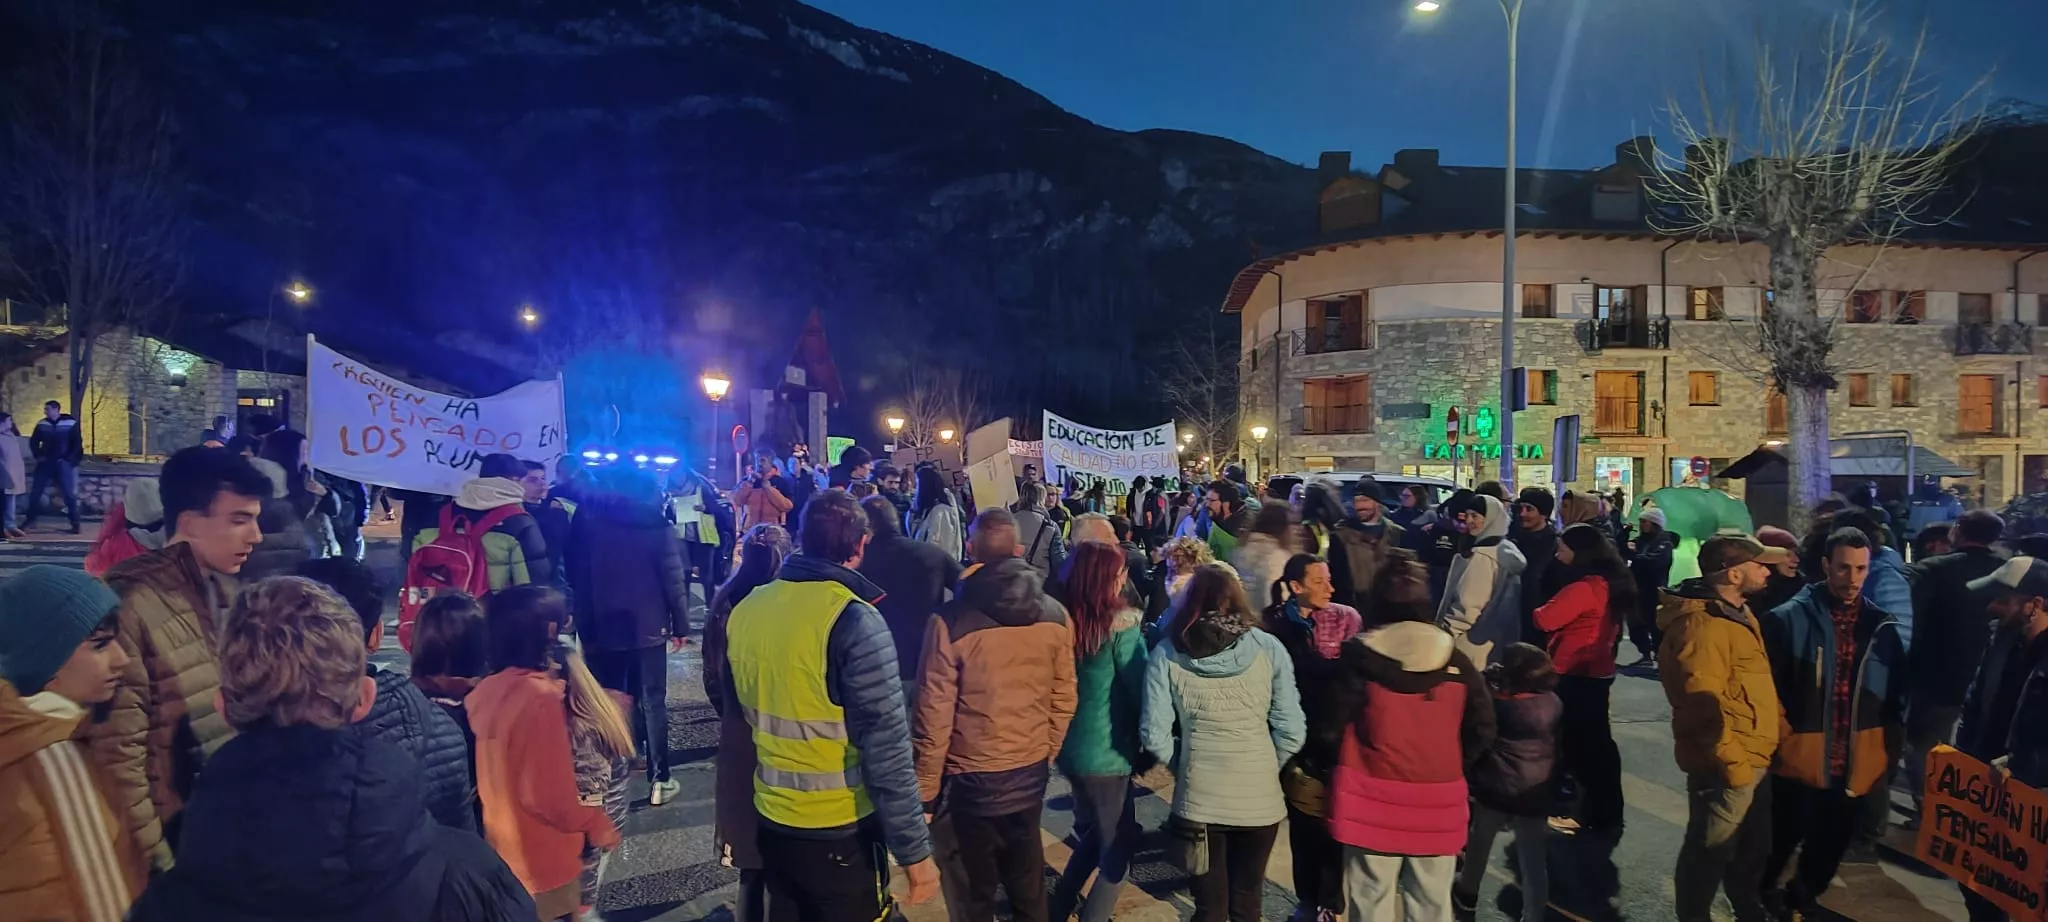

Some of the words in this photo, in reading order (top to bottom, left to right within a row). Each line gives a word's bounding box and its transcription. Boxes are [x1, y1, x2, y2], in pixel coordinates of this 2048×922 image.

[443, 399, 479, 420] HA
[340, 426, 406, 457] LOS
[538, 422, 559, 448] EN
[1144, 428, 1165, 447] DE
[1049, 443, 1112, 473] CALIDAD
[1117, 452, 1137, 471] NO
[1423, 444, 1544, 460] FARMACIA
[1930, 836, 1958, 866] EN
[1936, 804, 2028, 871] PENSADO
